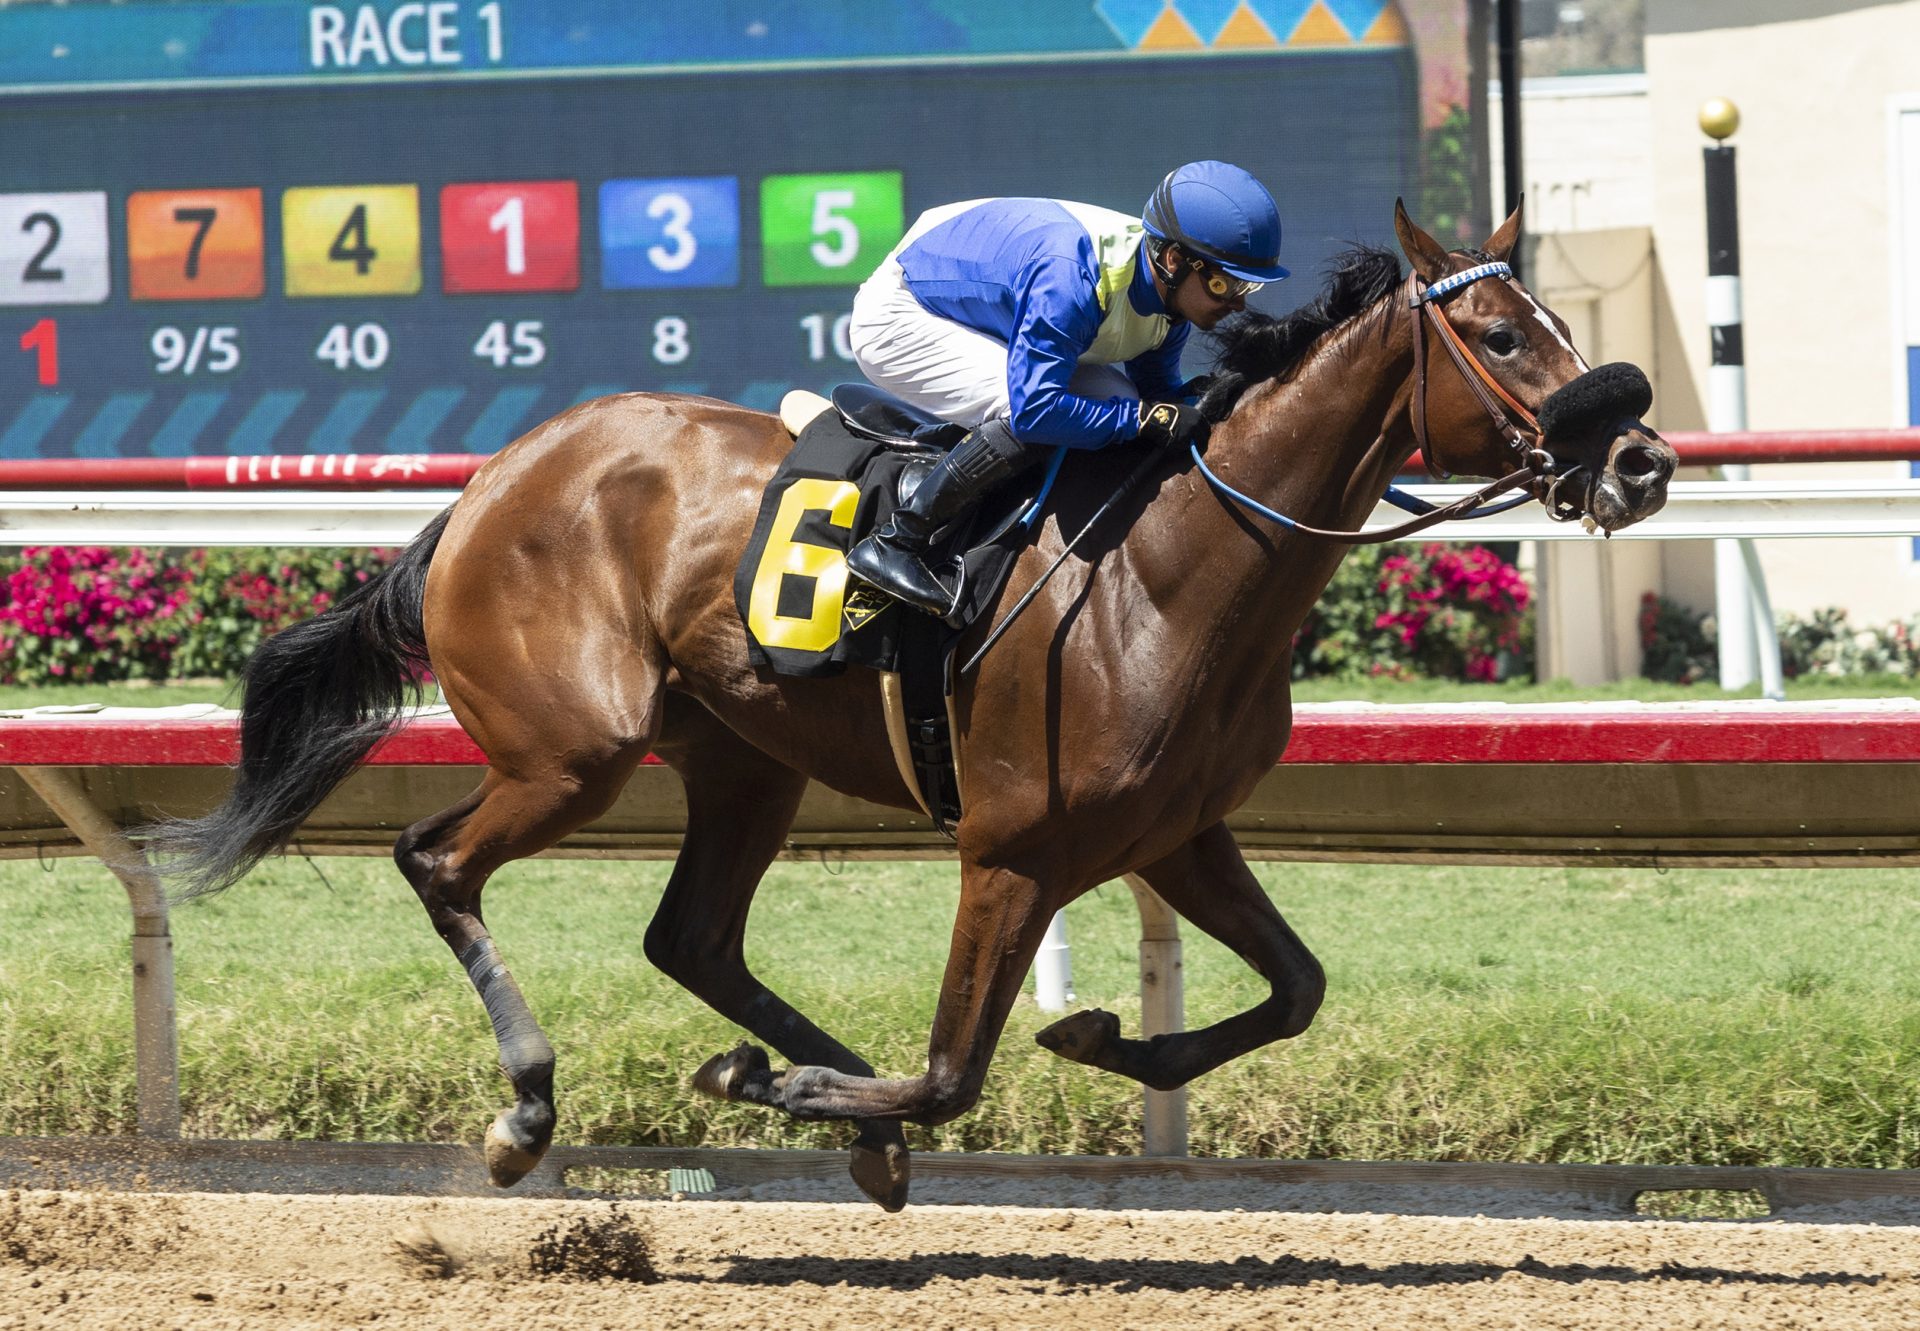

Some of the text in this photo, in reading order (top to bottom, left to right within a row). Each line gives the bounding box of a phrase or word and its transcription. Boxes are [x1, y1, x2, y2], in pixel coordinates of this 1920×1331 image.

[309, 2, 502, 67] RACE 1
[20, 189, 860, 283] 2 7 4 1 3 5
[20, 319, 58, 385] 1
[151, 327, 240, 374] 9/5
[316, 323, 390, 369] 40
[474, 321, 546, 366] 45
[652, 317, 690, 363] 8
[748, 478, 861, 652] 6
